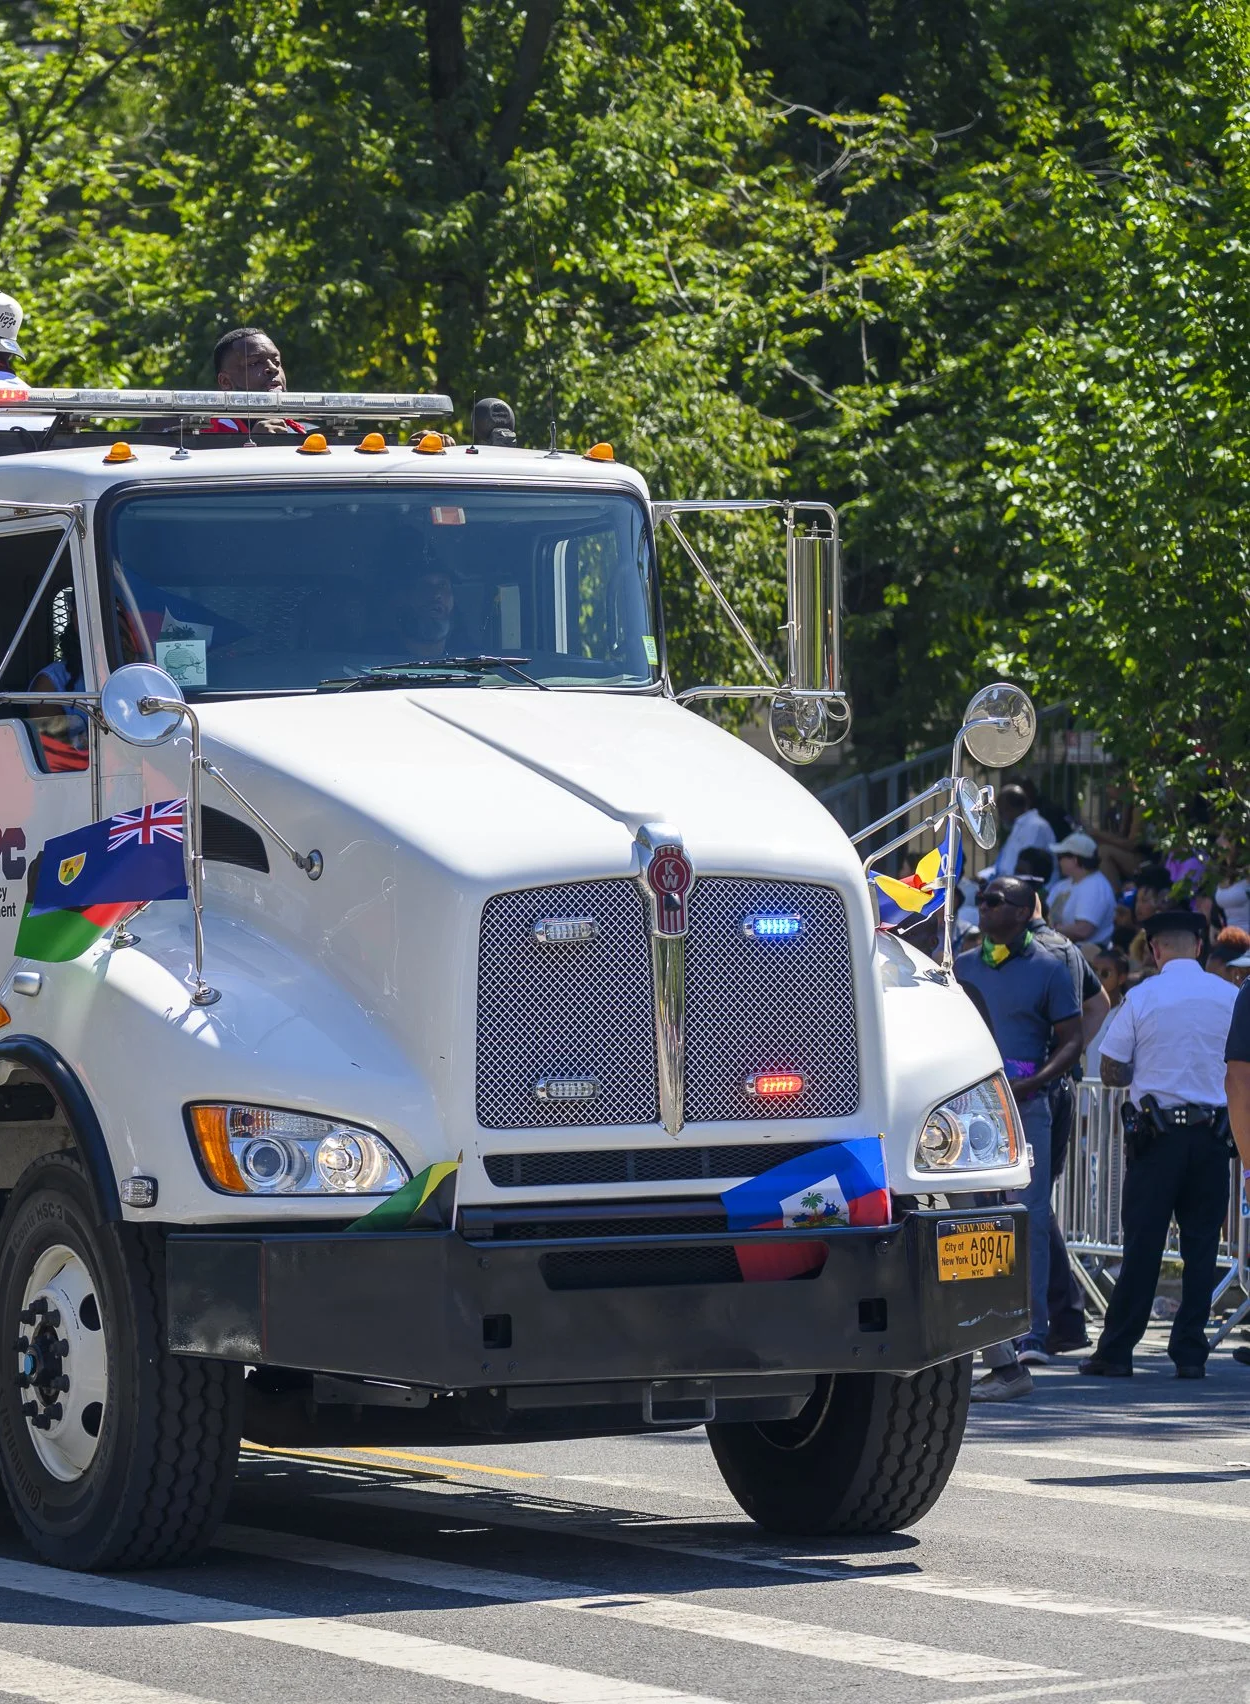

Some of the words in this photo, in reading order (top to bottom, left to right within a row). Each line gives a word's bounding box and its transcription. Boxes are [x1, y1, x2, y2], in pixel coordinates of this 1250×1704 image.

[664, 861, 676, 875] K
[662, 875, 679, 889] W
[956, 1223, 975, 1233] NEW
[976, 1221, 996, 1232] YORK
[944, 1242, 956, 1253] City
[957, 1241, 964, 1251] of
[941, 1256, 954, 1266] New
[955, 1255, 969, 1265] York
[971, 1268, 984, 1277] NYC
